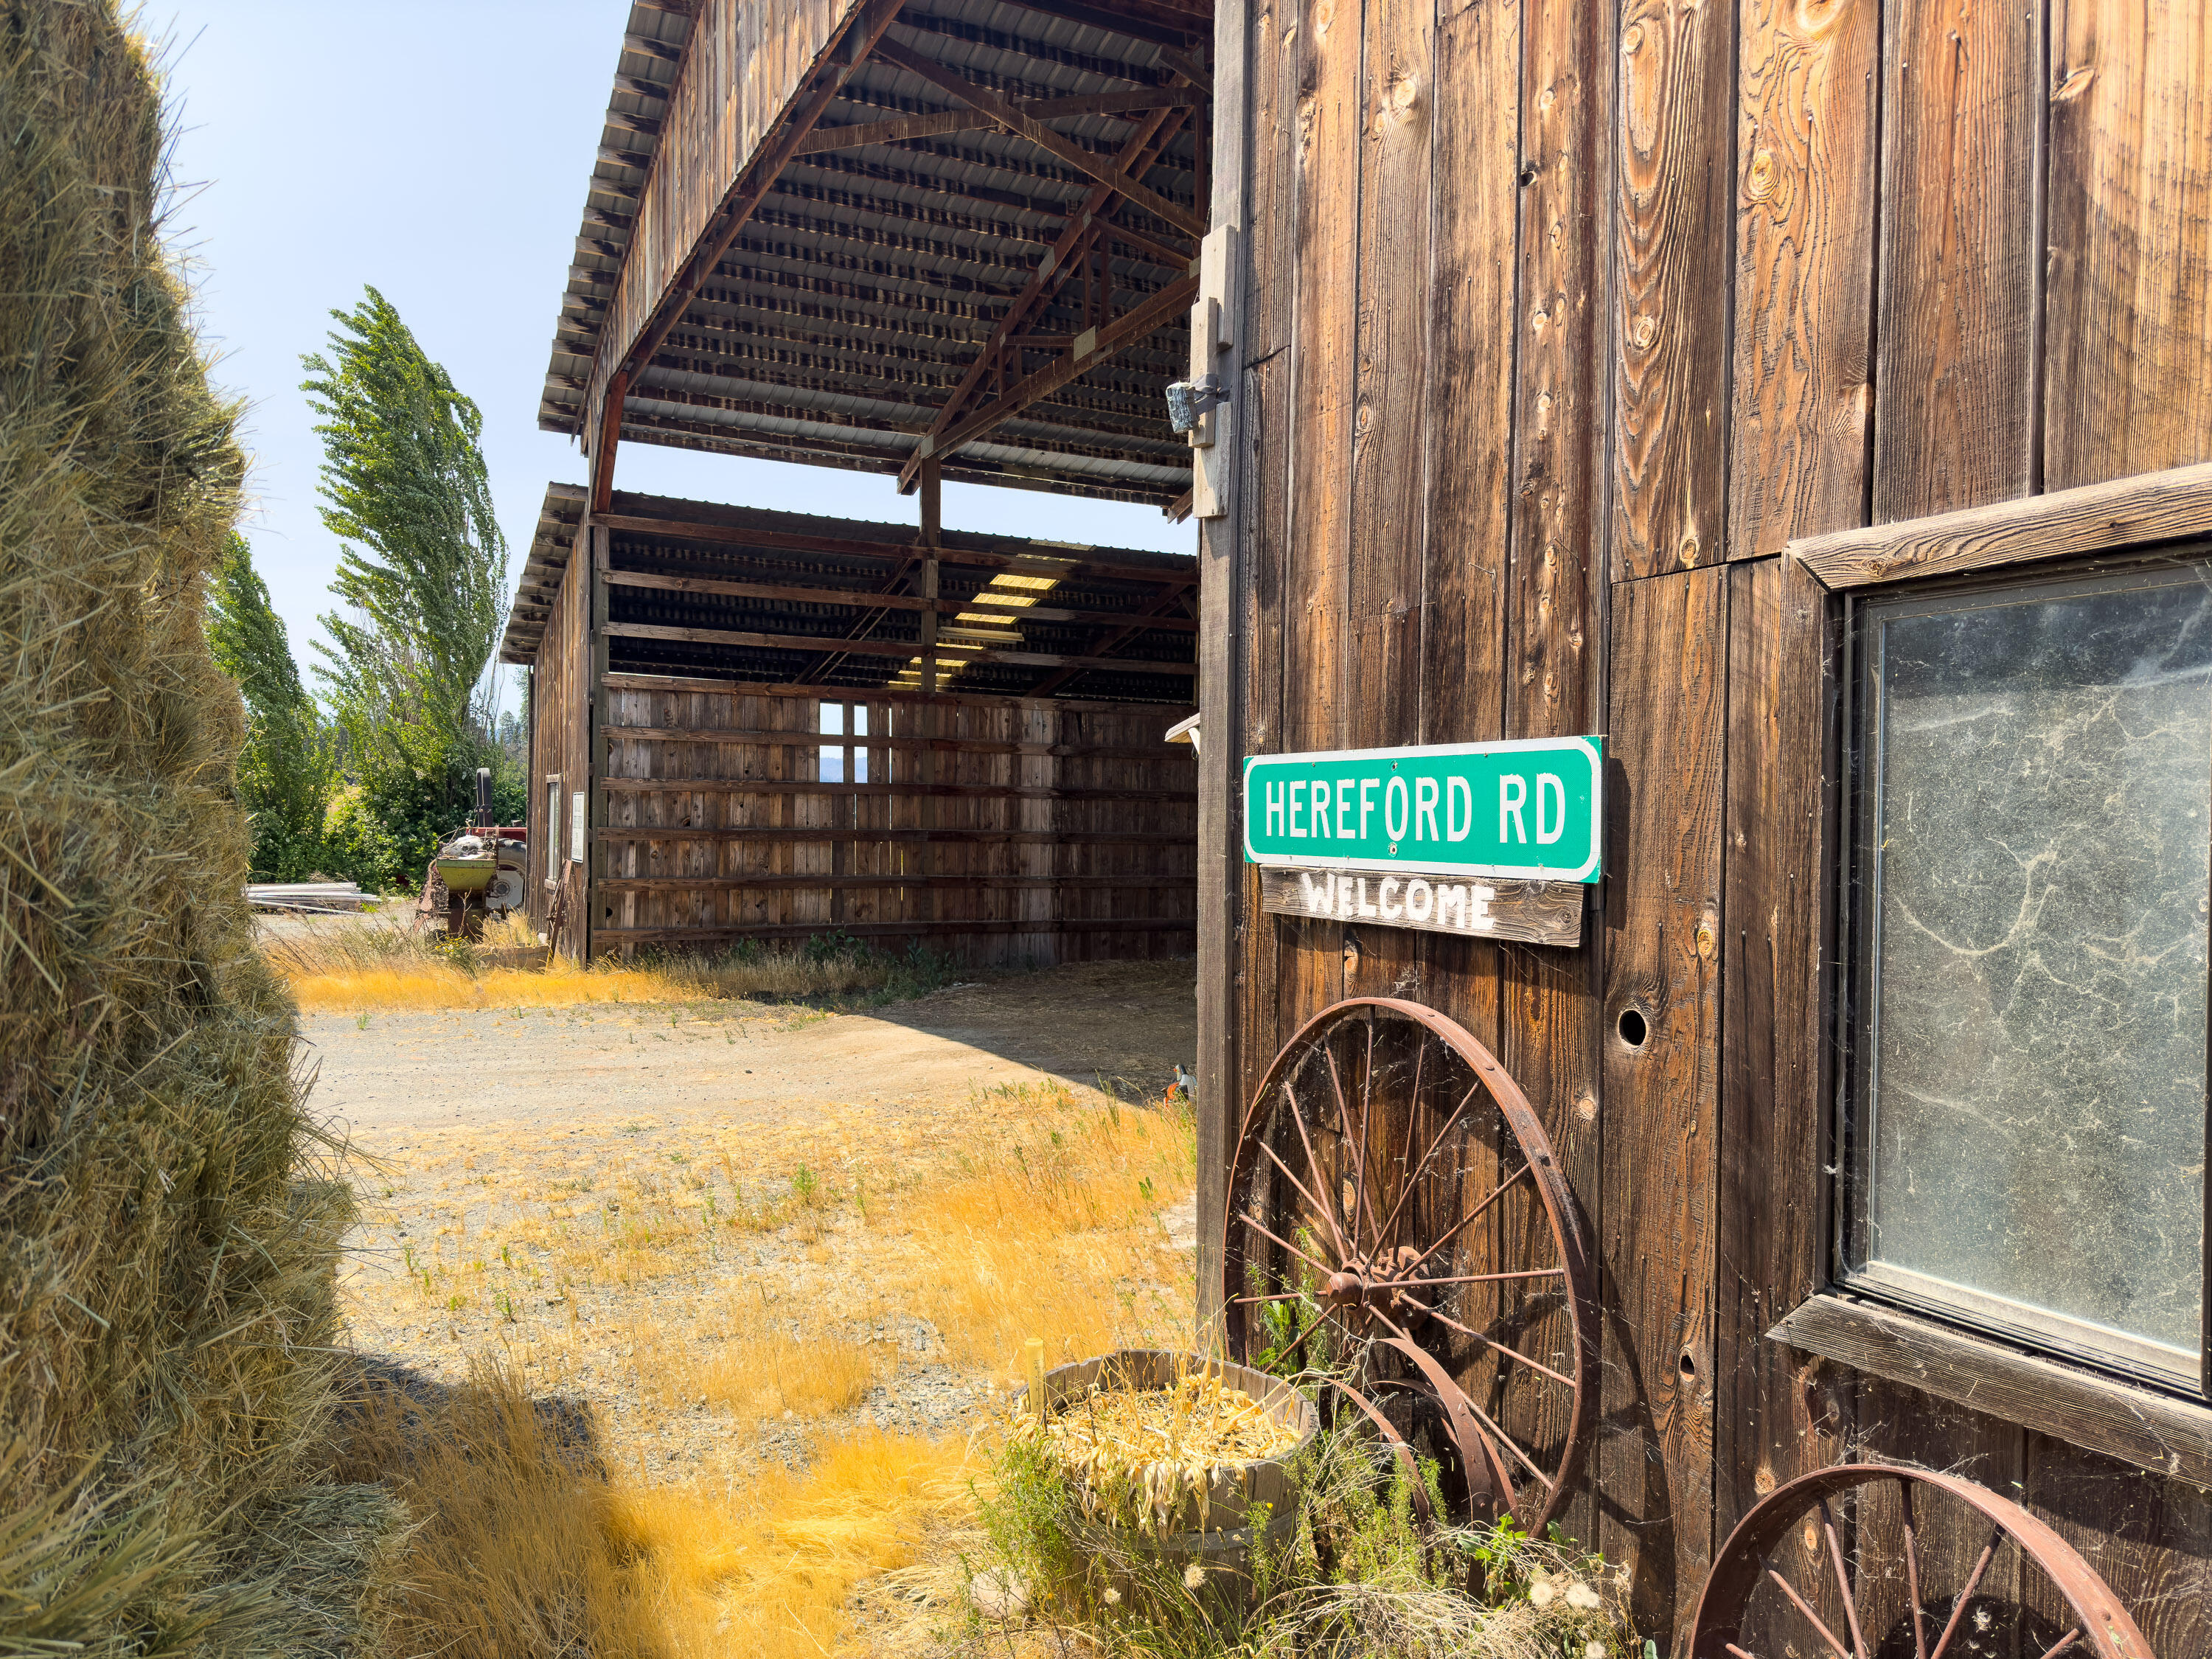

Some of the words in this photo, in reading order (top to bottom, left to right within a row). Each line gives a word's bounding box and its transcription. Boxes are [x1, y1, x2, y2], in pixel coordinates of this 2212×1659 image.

[1266, 775, 1472, 842] HEREFORD
[1499, 772, 1566, 845] RD
[1301, 872, 1495, 931] WELCOME
